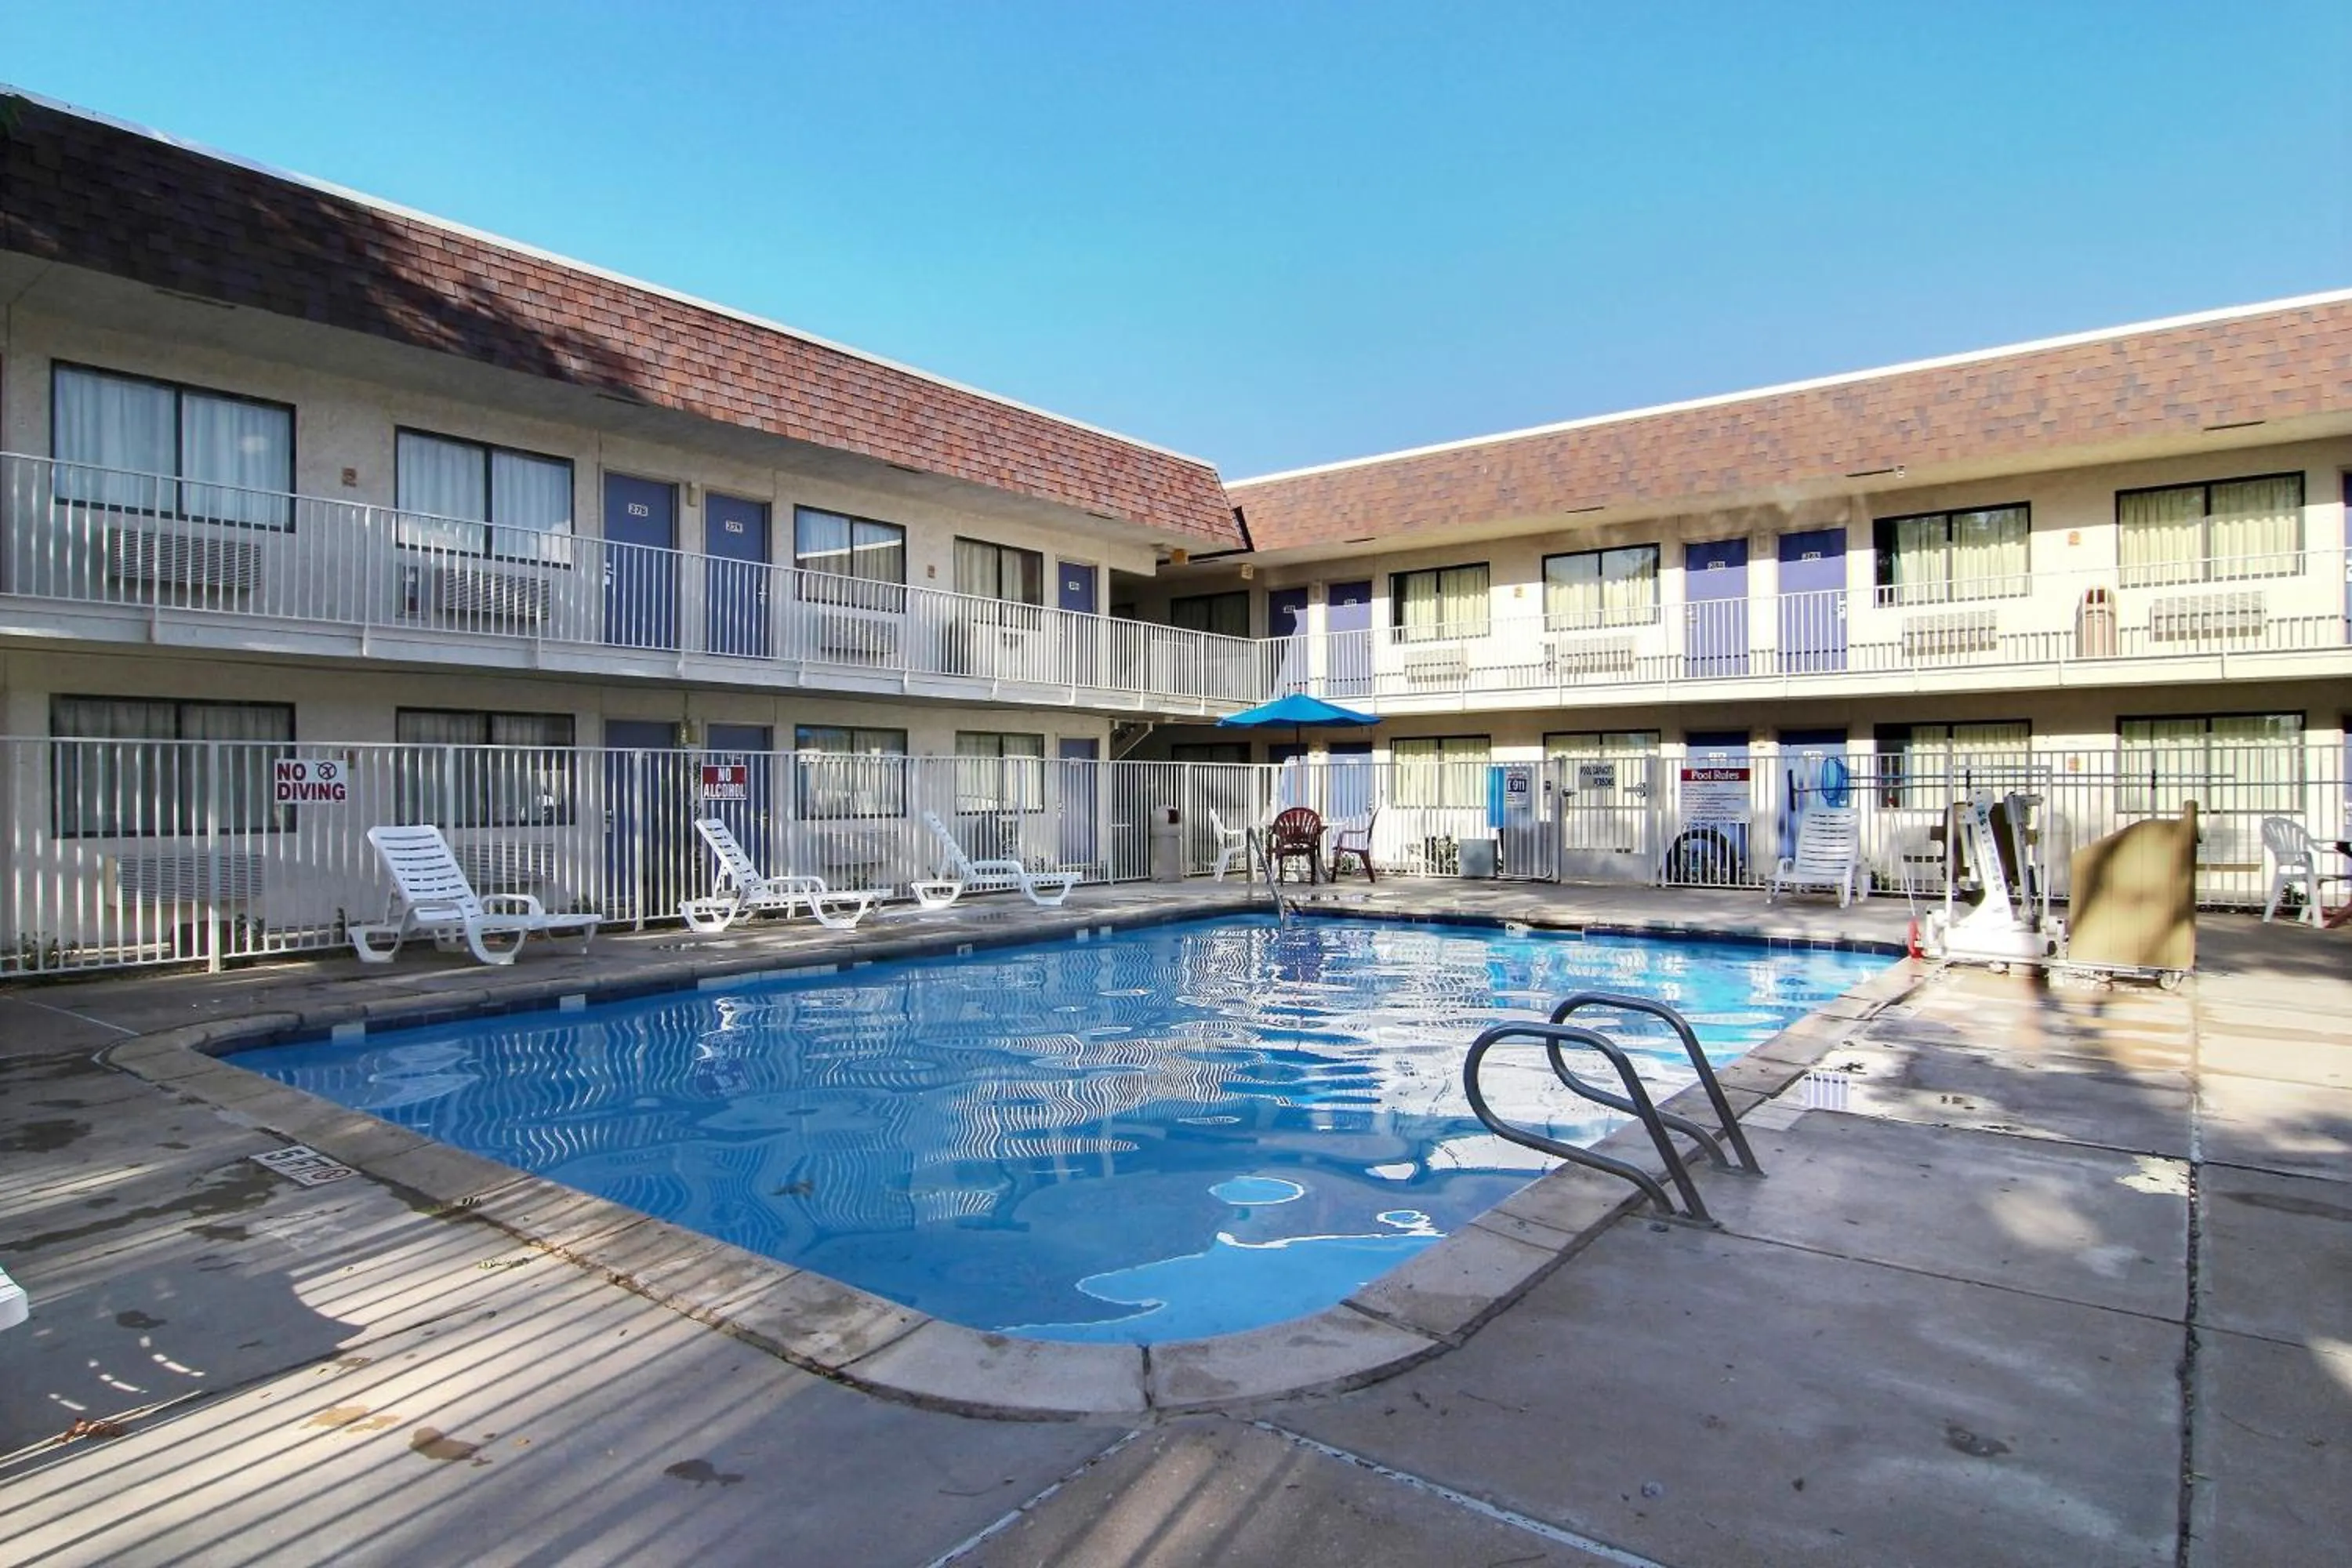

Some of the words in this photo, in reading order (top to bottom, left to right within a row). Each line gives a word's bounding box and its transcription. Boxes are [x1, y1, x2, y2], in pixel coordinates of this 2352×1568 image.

[277, 763, 307, 781] NO
[717, 768, 731, 782] NO
[1691, 770, 1711, 780] Pool
[1713, 770, 1740, 780] Rules
[277, 782, 346, 800] DIVING
[703, 783, 746, 797] ALCOHOL
